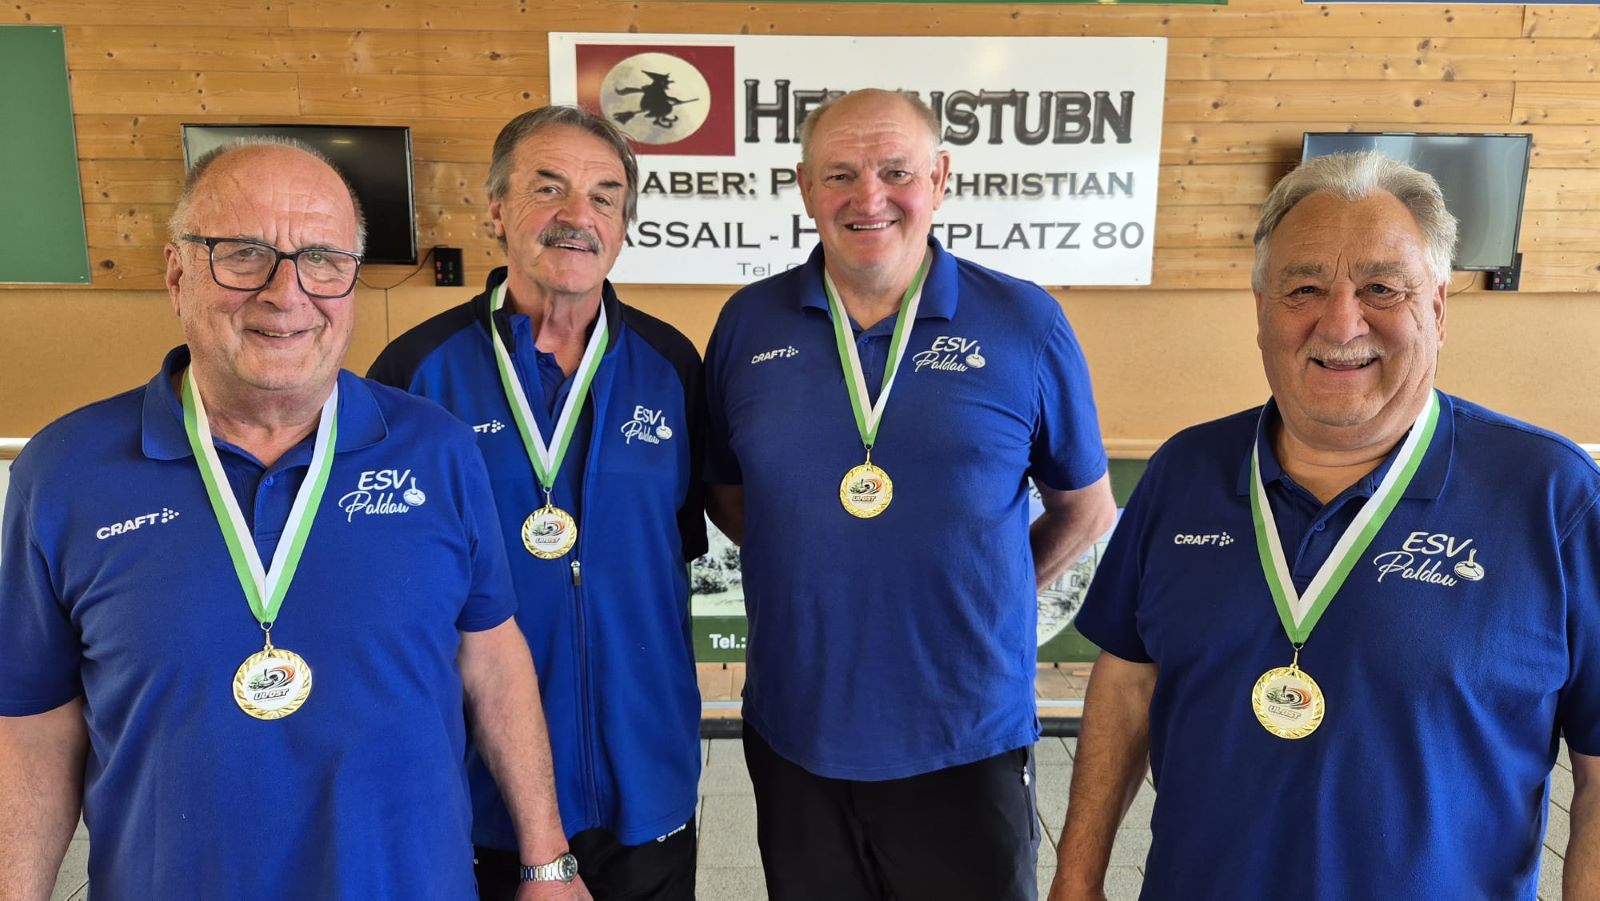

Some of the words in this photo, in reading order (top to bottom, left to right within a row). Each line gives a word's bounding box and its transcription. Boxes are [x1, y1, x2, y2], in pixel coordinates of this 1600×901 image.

[944, 172, 1134, 197] HRISTIAN
[1092, 221, 1144, 249] 80
[751, 348, 787, 364] CRAFT
[931, 336, 978, 354] ESV
[912, 350, 969, 373] Paldau
[633, 405, 662, 426] ESV
[357, 469, 411, 491] ESV
[338, 490, 411, 523] Paldau
[96, 512, 160, 540] CRAFT
[1174, 533, 1219, 546] CRAFT
[1402, 532, 1472, 558] ESV
[1373, 551, 1457, 587] Paldau
[708, 633, 747, 649] Tel.:
